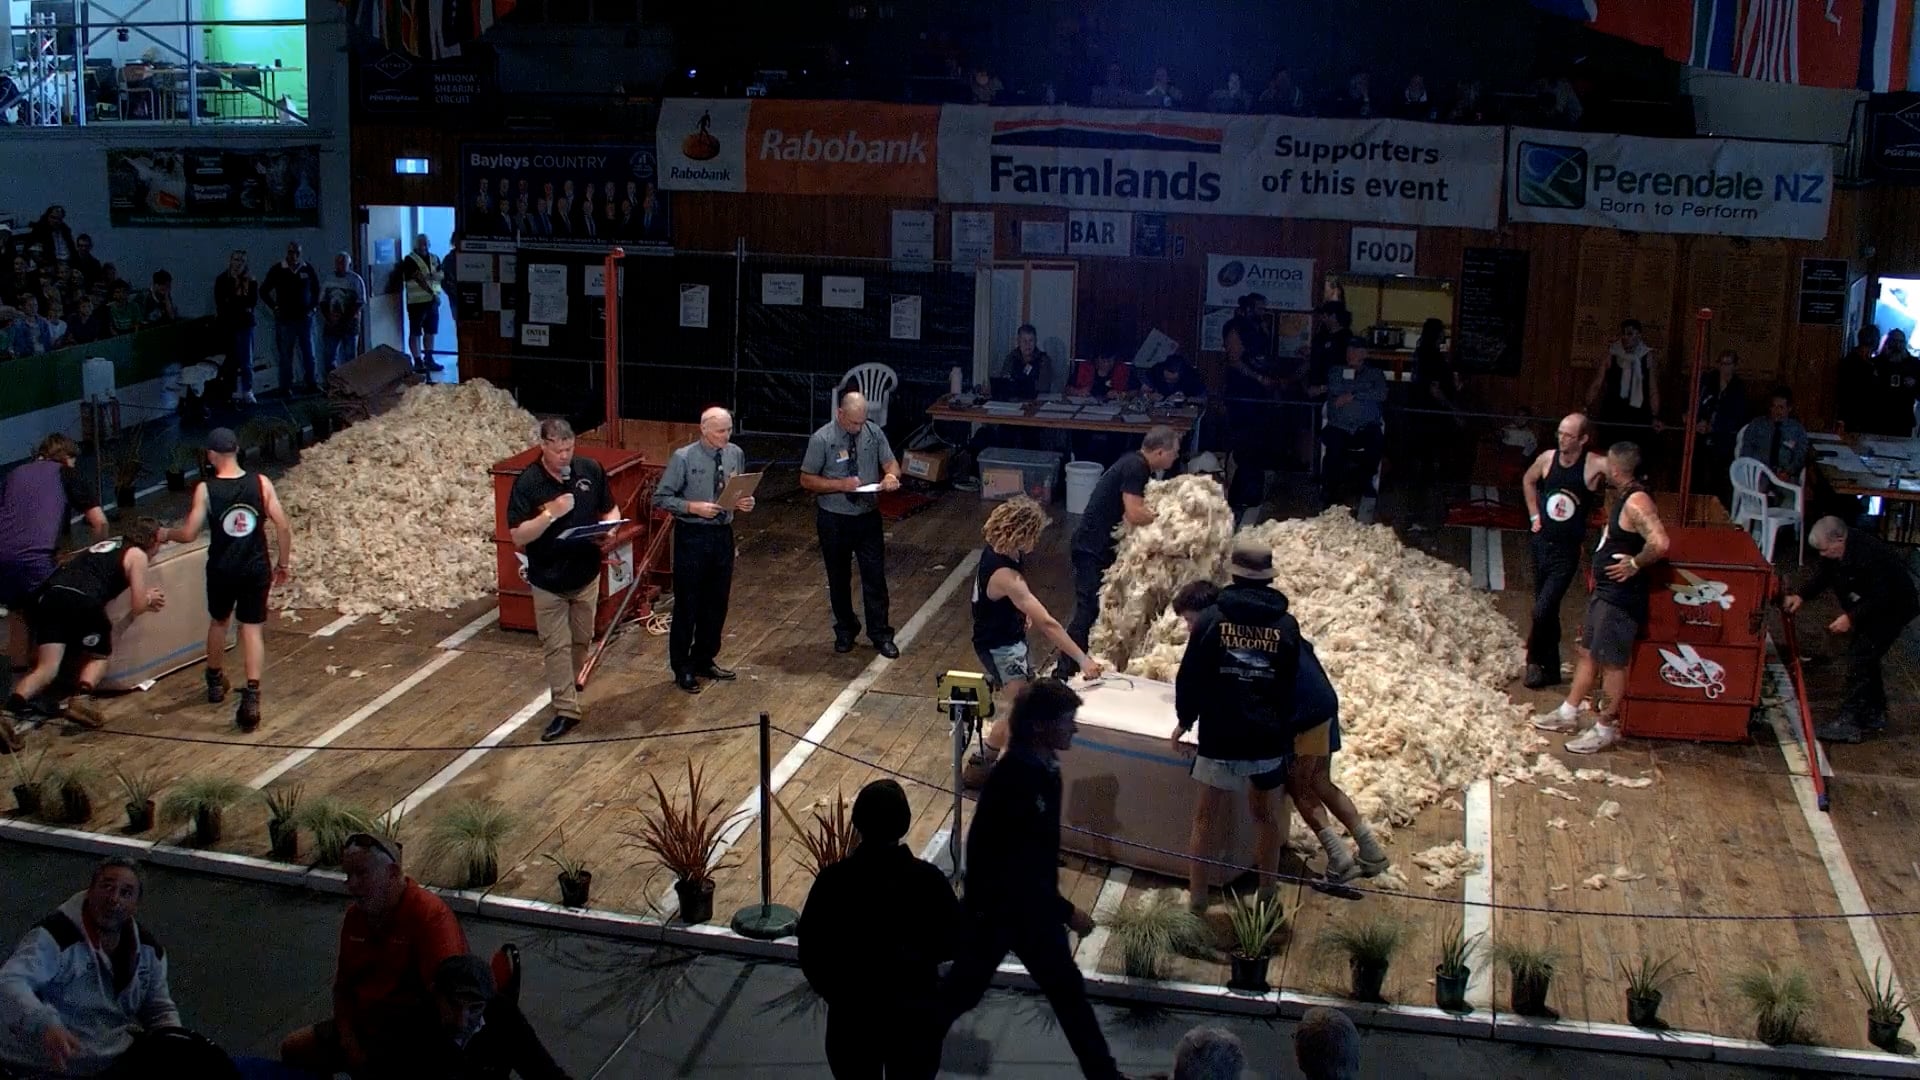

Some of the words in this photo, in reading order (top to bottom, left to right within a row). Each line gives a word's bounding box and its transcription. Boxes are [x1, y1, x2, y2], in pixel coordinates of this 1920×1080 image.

[434, 95, 470, 104] CIRCUIT
[758, 128, 929, 165] Rabobank
[1275, 134, 1439, 164] Supporters
[470, 152, 530, 170] Bayleys
[533, 154, 607, 169] COUNTRY
[670, 166, 731, 181] Rabobank
[990, 155, 1221, 202] Farmlands
[1262, 168, 1293, 193] of
[1301, 169, 1355, 195] this
[1365, 177, 1449, 201] event
[1594, 164, 1763, 201] Perendale
[1774, 173, 1824, 204] NZ
[1600, 197, 1645, 213] Born
[1655, 201, 1673, 216] to
[1681, 202, 1758, 220] Perform
[1070, 220, 1115, 244] BAR
[1356, 241, 1414, 263] FOOD
[1247, 263, 1303, 280] Amoa
[1247, 280, 1303, 289] SEAF
[1219, 621, 1281, 641] THUNNUS
